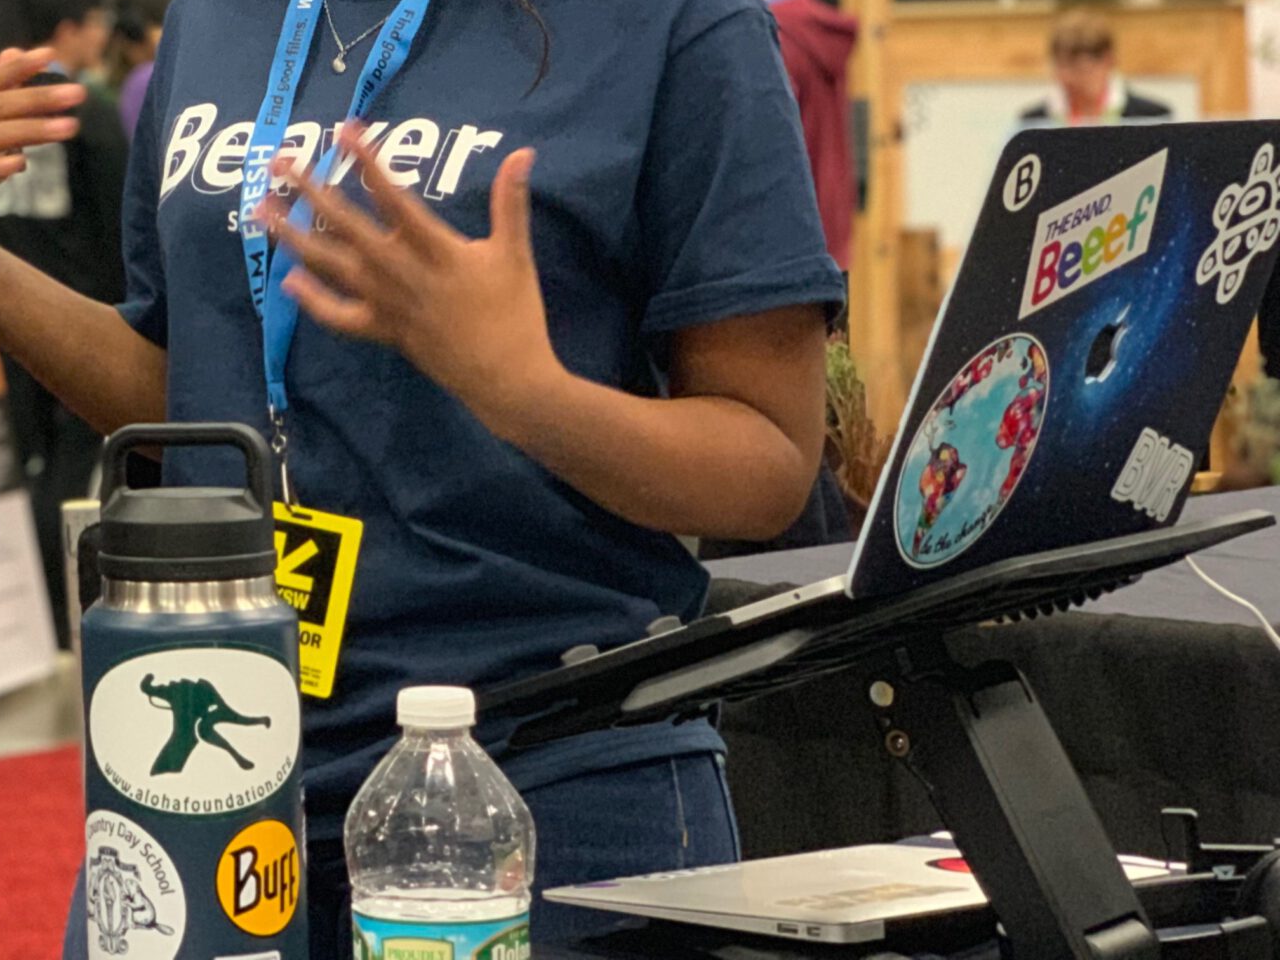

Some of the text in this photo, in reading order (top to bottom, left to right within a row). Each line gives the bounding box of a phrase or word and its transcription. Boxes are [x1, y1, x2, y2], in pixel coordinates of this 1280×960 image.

[389, 8, 416, 42] Find
[276, 59, 297, 91] good
[372, 40, 397, 82] good
[264, 94, 285, 127] Find
[159, 102, 504, 204] Beaver
[243, 144, 274, 240] FRESH
[1013, 160, 1035, 207] B
[1044, 193, 1113, 242] THE BAND
[1031, 184, 1156, 307] Beeef
[248, 249, 266, 325] ILM
[277, 586, 310, 611] SW
[104, 755, 293, 813] www.alohafoundation.org
[116, 820, 141, 850] Day
[139, 841, 177, 897] School
